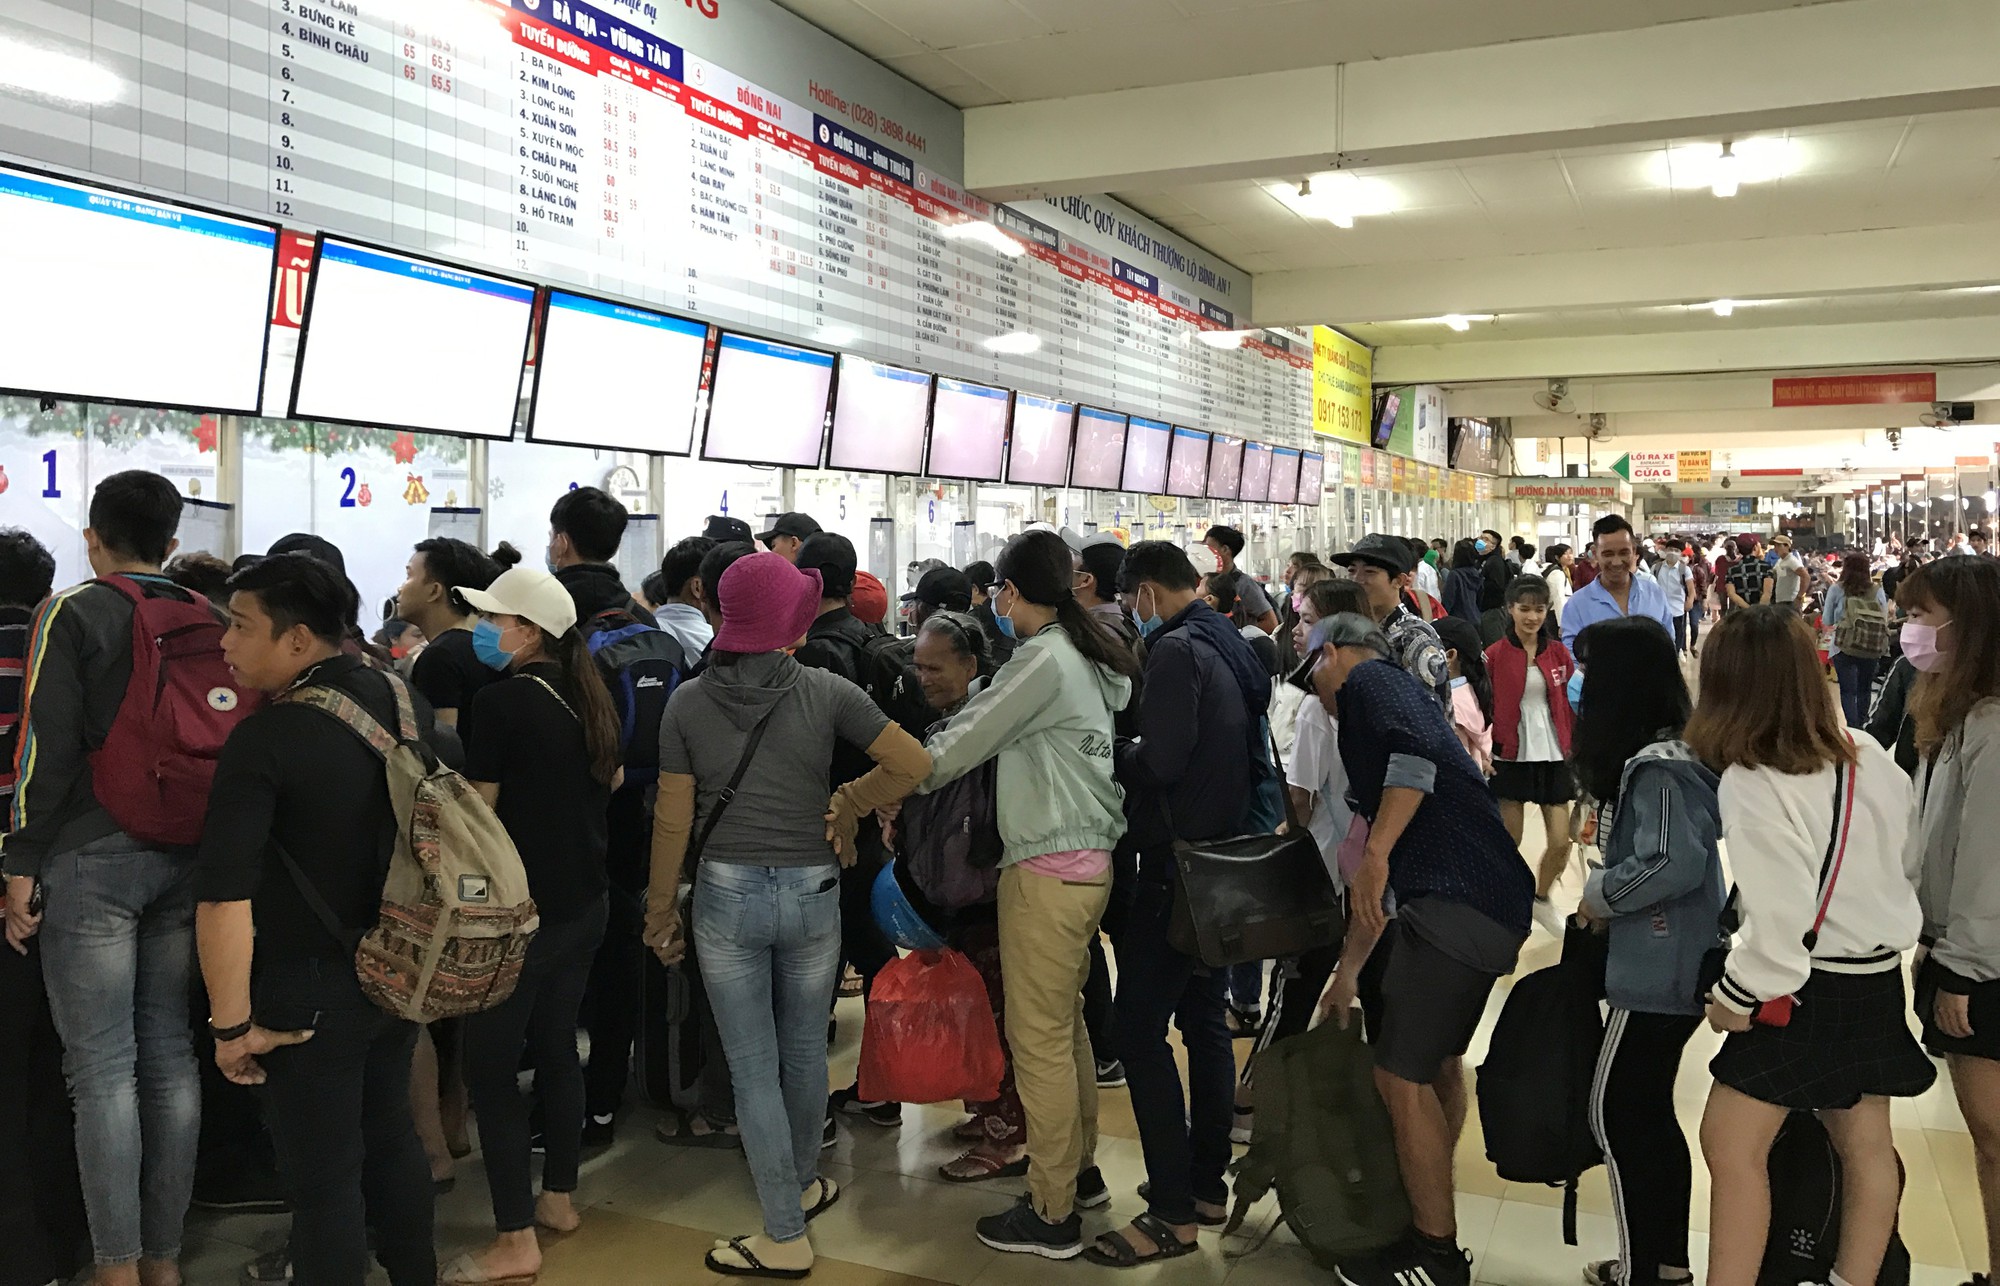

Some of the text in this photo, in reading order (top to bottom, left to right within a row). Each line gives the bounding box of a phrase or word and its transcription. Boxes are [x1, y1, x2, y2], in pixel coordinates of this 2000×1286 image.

[281, 0, 295, 14] 3.
[299, 5, 335, 29] BƯNG
[281, 22, 369, 64] 4. BÌNH CHÂU
[553, 0, 571, 25] BÀ
[575, 12, 597, 38] RỊA
[610, 26, 644, 58] VŨNG
[647, 41, 670, 69] TÀU
[281, 44, 295, 59] 5.
[404, 43, 451, 73] 65 65.5
[520, 51, 528, 63] 1.
[281, 67, 295, 82] 6.
[404, 64, 451, 93] 65 65.5
[519, 70, 576, 101] 2. KIM LONG
[282, 89, 295, 104] 7.
[520, 89, 529, 101] 3.
[532, 94, 556, 111] LONG
[281, 112, 295, 127] 8.
[766, 100, 782, 121] NAI
[809, 79, 927, 154] Hotline: (028) 3898 4441
[519, 108, 577, 138] 4. XUÂN SƠN
[520, 127, 529, 139] 5.
[281, 135, 295, 150] 9.
[854, 141, 867, 161] NAI
[276, 155, 294, 172] 10.
[519, 146, 577, 174] 6. CHÂU PHA
[520, 165, 529, 177] 7.
[276, 178, 294, 194] 11.
[519, 184, 529, 196] 8.
[532, 187, 557, 204] LÁNG
[712, 179, 726, 192] RAY
[275, 201, 294, 217] 12.
[520, 203, 529, 215] 9.
[516, 220, 529, 233] 10.
[516, 239, 529, 252] 11.
[1094, 209, 1115, 236] QUÝ
[1118, 221, 1151, 255] KHÁCH
[1152, 240, 1185, 272] THƯỢNG
[1187, 258, 1197, 282] LỘ
[1199, 264, 1216, 289] BÌNH
[1217, 276, 1227, 295] AN
[516, 258, 529, 271] 12.
[1318, 398, 1362, 432] 0917 153 173
[41, 449, 62, 499] 1
[1663, 469, 1671, 477] G
[340, 467, 357, 508] 2
[1599, 486, 1614, 497] TIN
[720, 490, 728, 517] 4
[839, 496, 846, 520] 5
[928, 500, 934, 524] 6
